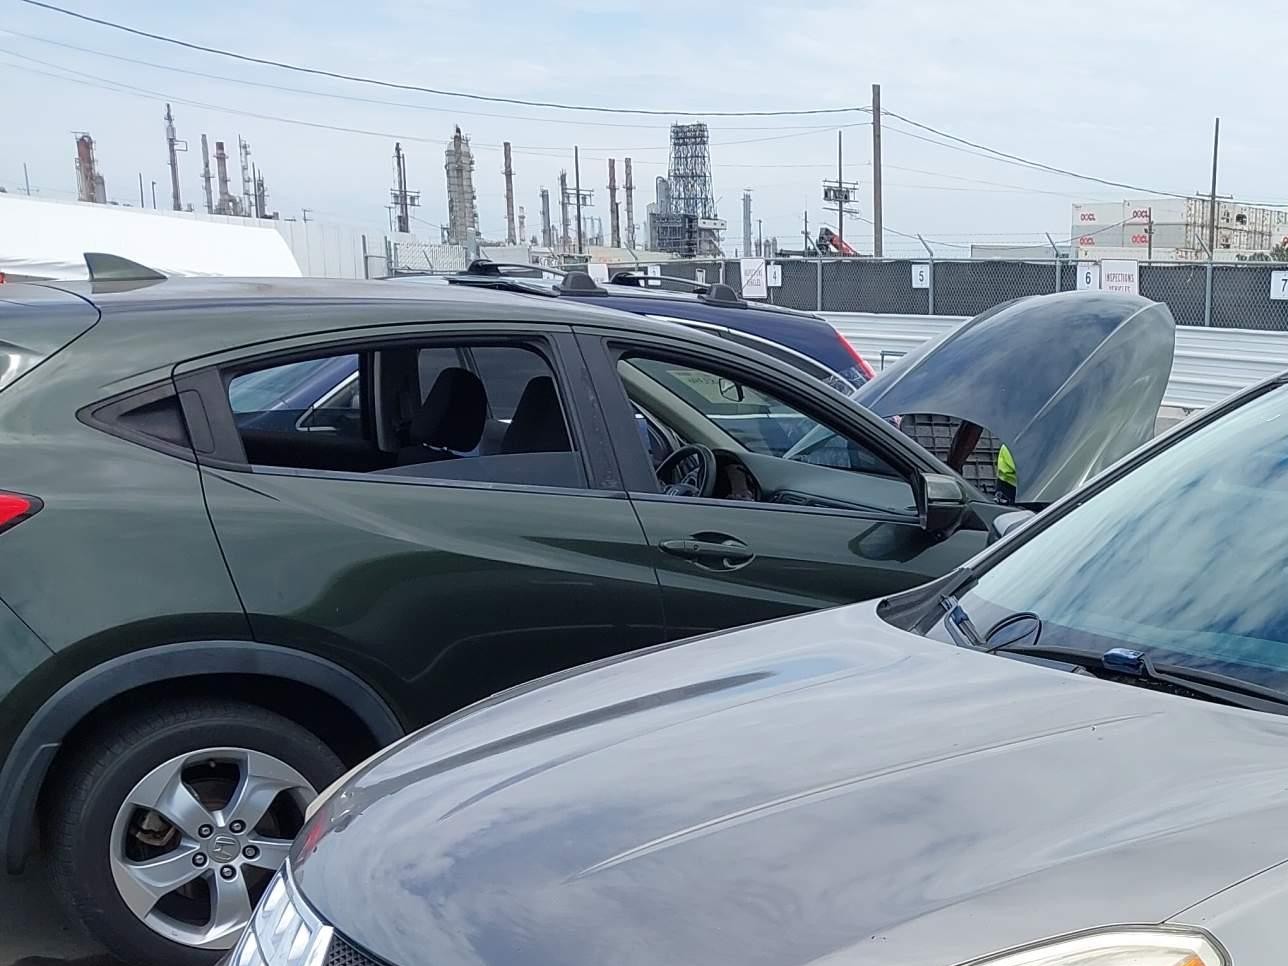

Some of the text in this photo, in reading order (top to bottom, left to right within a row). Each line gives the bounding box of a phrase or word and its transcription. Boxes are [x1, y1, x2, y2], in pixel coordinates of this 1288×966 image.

[919, 270, 924, 282] 5
[1085, 271, 1092, 285] 6
[1281, 278, 1288, 292] 7
